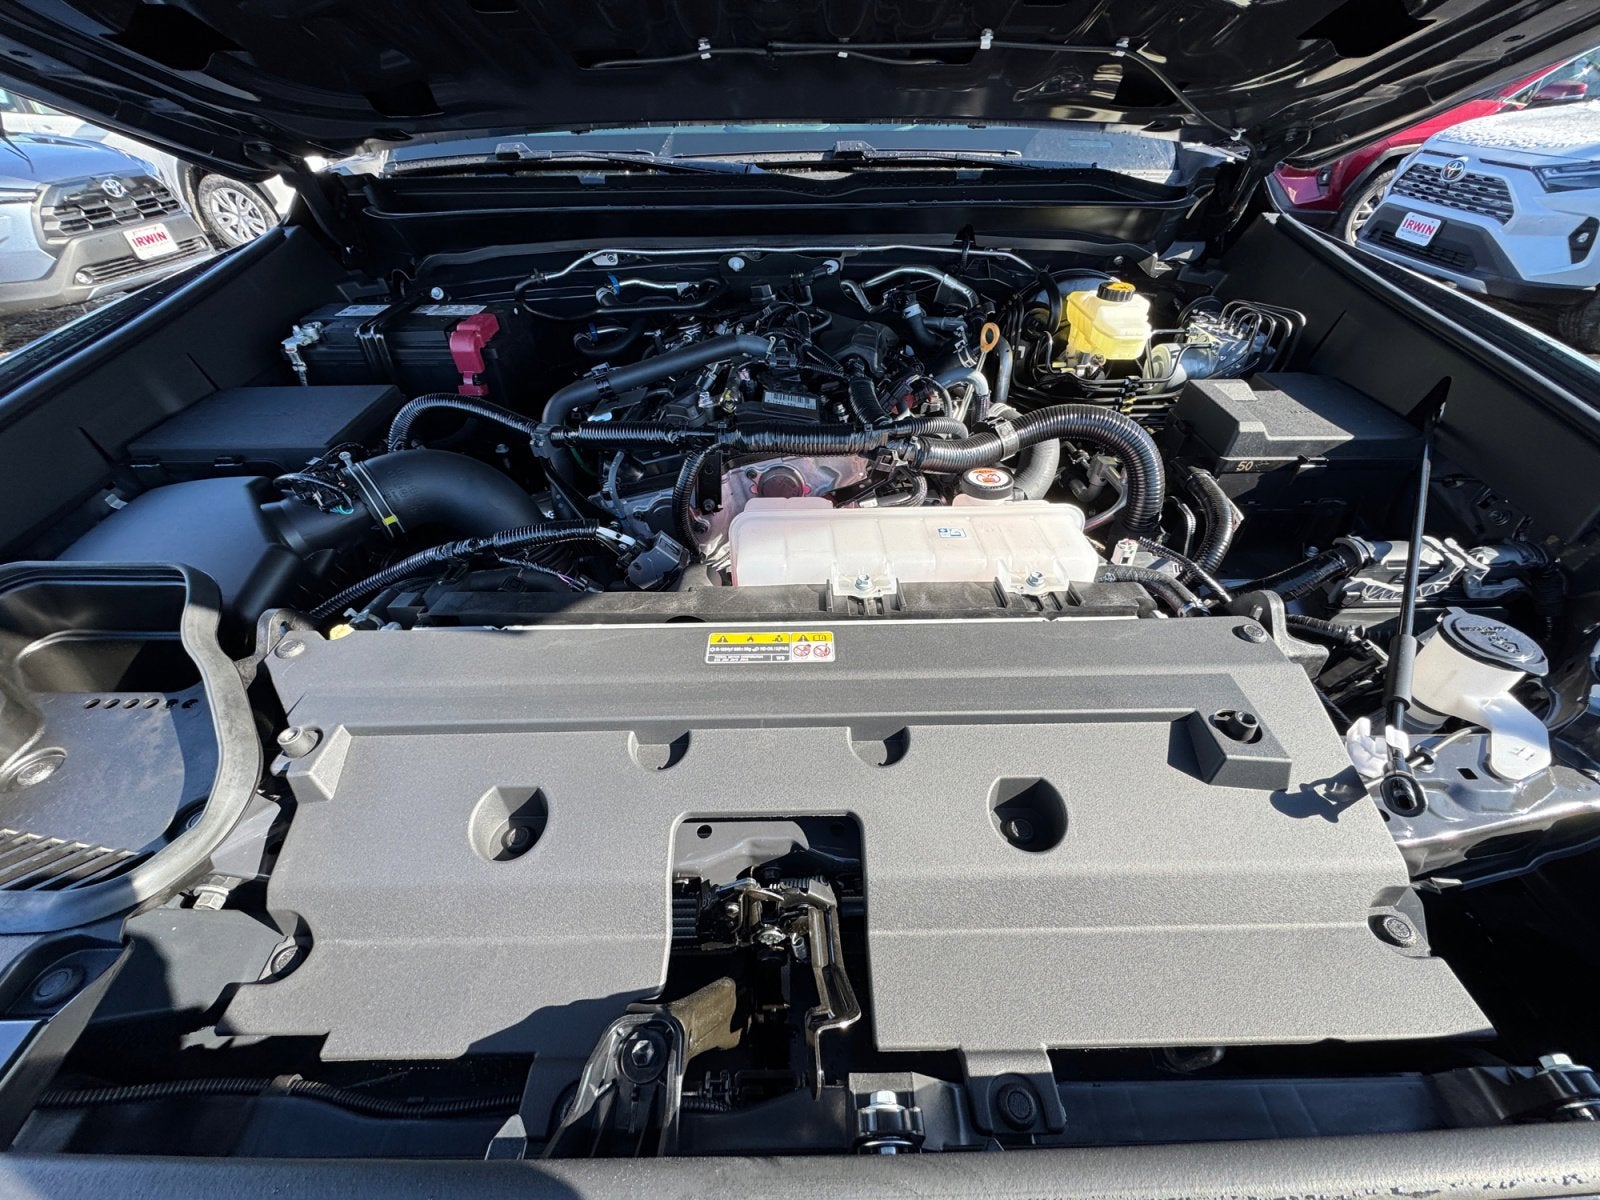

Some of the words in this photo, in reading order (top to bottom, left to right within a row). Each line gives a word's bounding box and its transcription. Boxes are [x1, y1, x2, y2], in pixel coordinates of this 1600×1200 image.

[1402, 218, 1435, 235] IRWIN
[132, 231, 168, 247] IRWIN
[1236, 460, 1254, 471] 50
